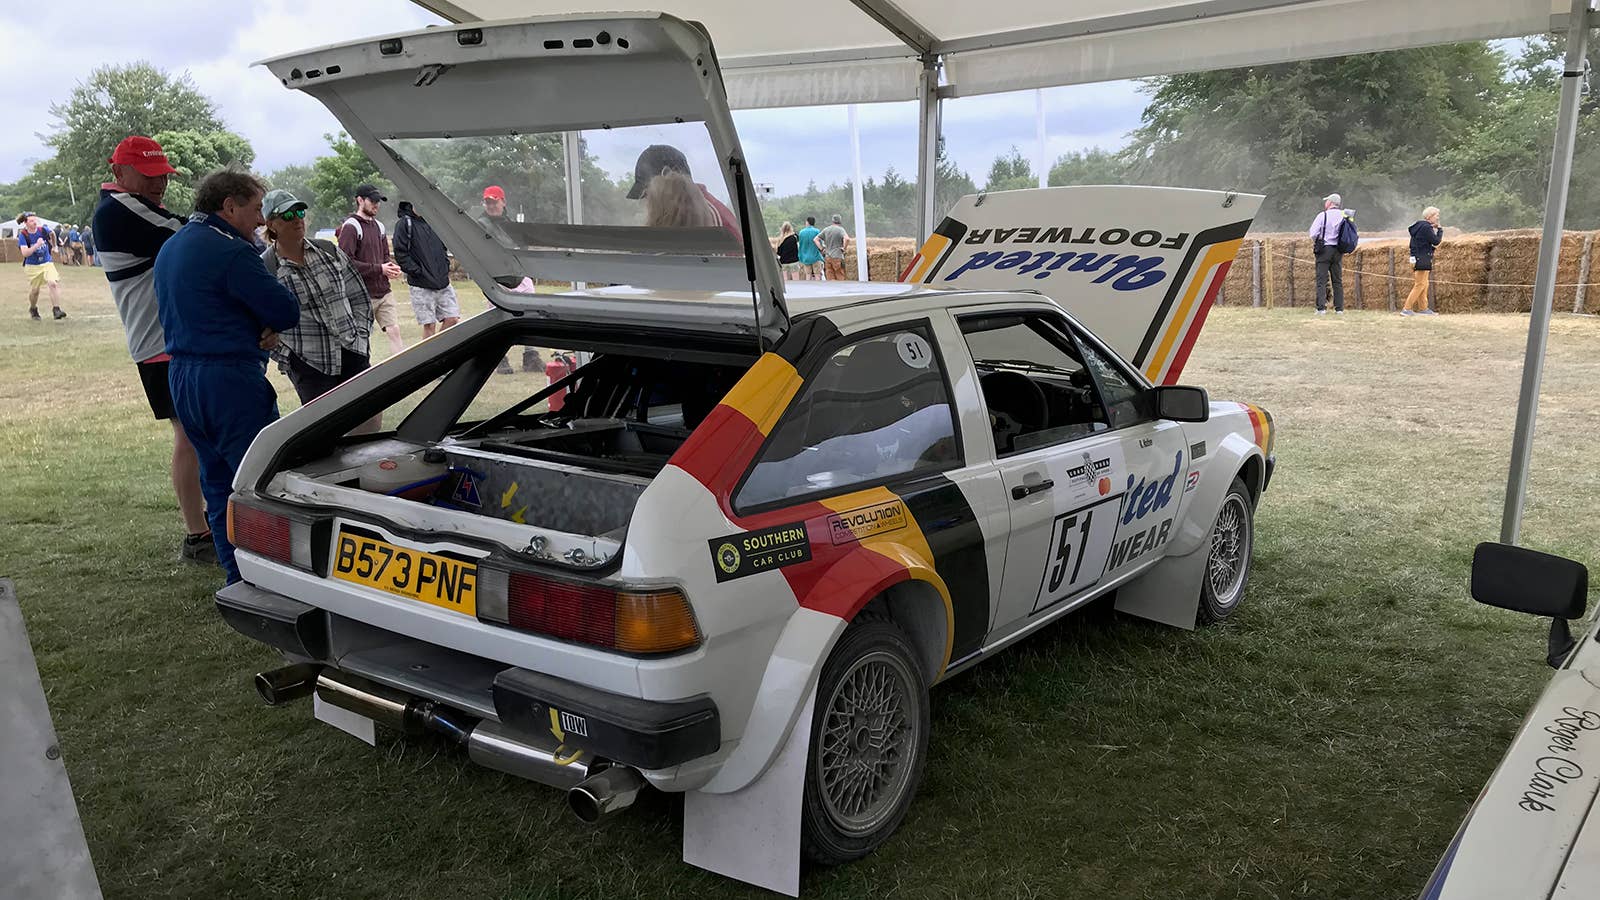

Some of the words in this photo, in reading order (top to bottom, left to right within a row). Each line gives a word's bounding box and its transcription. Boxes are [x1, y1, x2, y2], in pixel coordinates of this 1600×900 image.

[964, 227, 1190, 250] FOOTWEAR
[943, 250, 1167, 291] United
[905, 341, 924, 360] 51
[1120, 449, 1182, 526] ited
[743, 527, 805, 551] SOUTHERN
[832, 505, 901, 532] REVOLUTION
[753, 556, 774, 568] CAR
[777, 549, 803, 562] CLUB
[1048, 510, 1093, 593] 51
[1108, 517, 1173, 572] WEAR
[336, 537, 412, 589] B573
[416, 556, 477, 604] PNF
[562, 712, 587, 736] TOW
[1543, 706, 1600, 755] Roger
[1518, 756, 1583, 812] Clark
